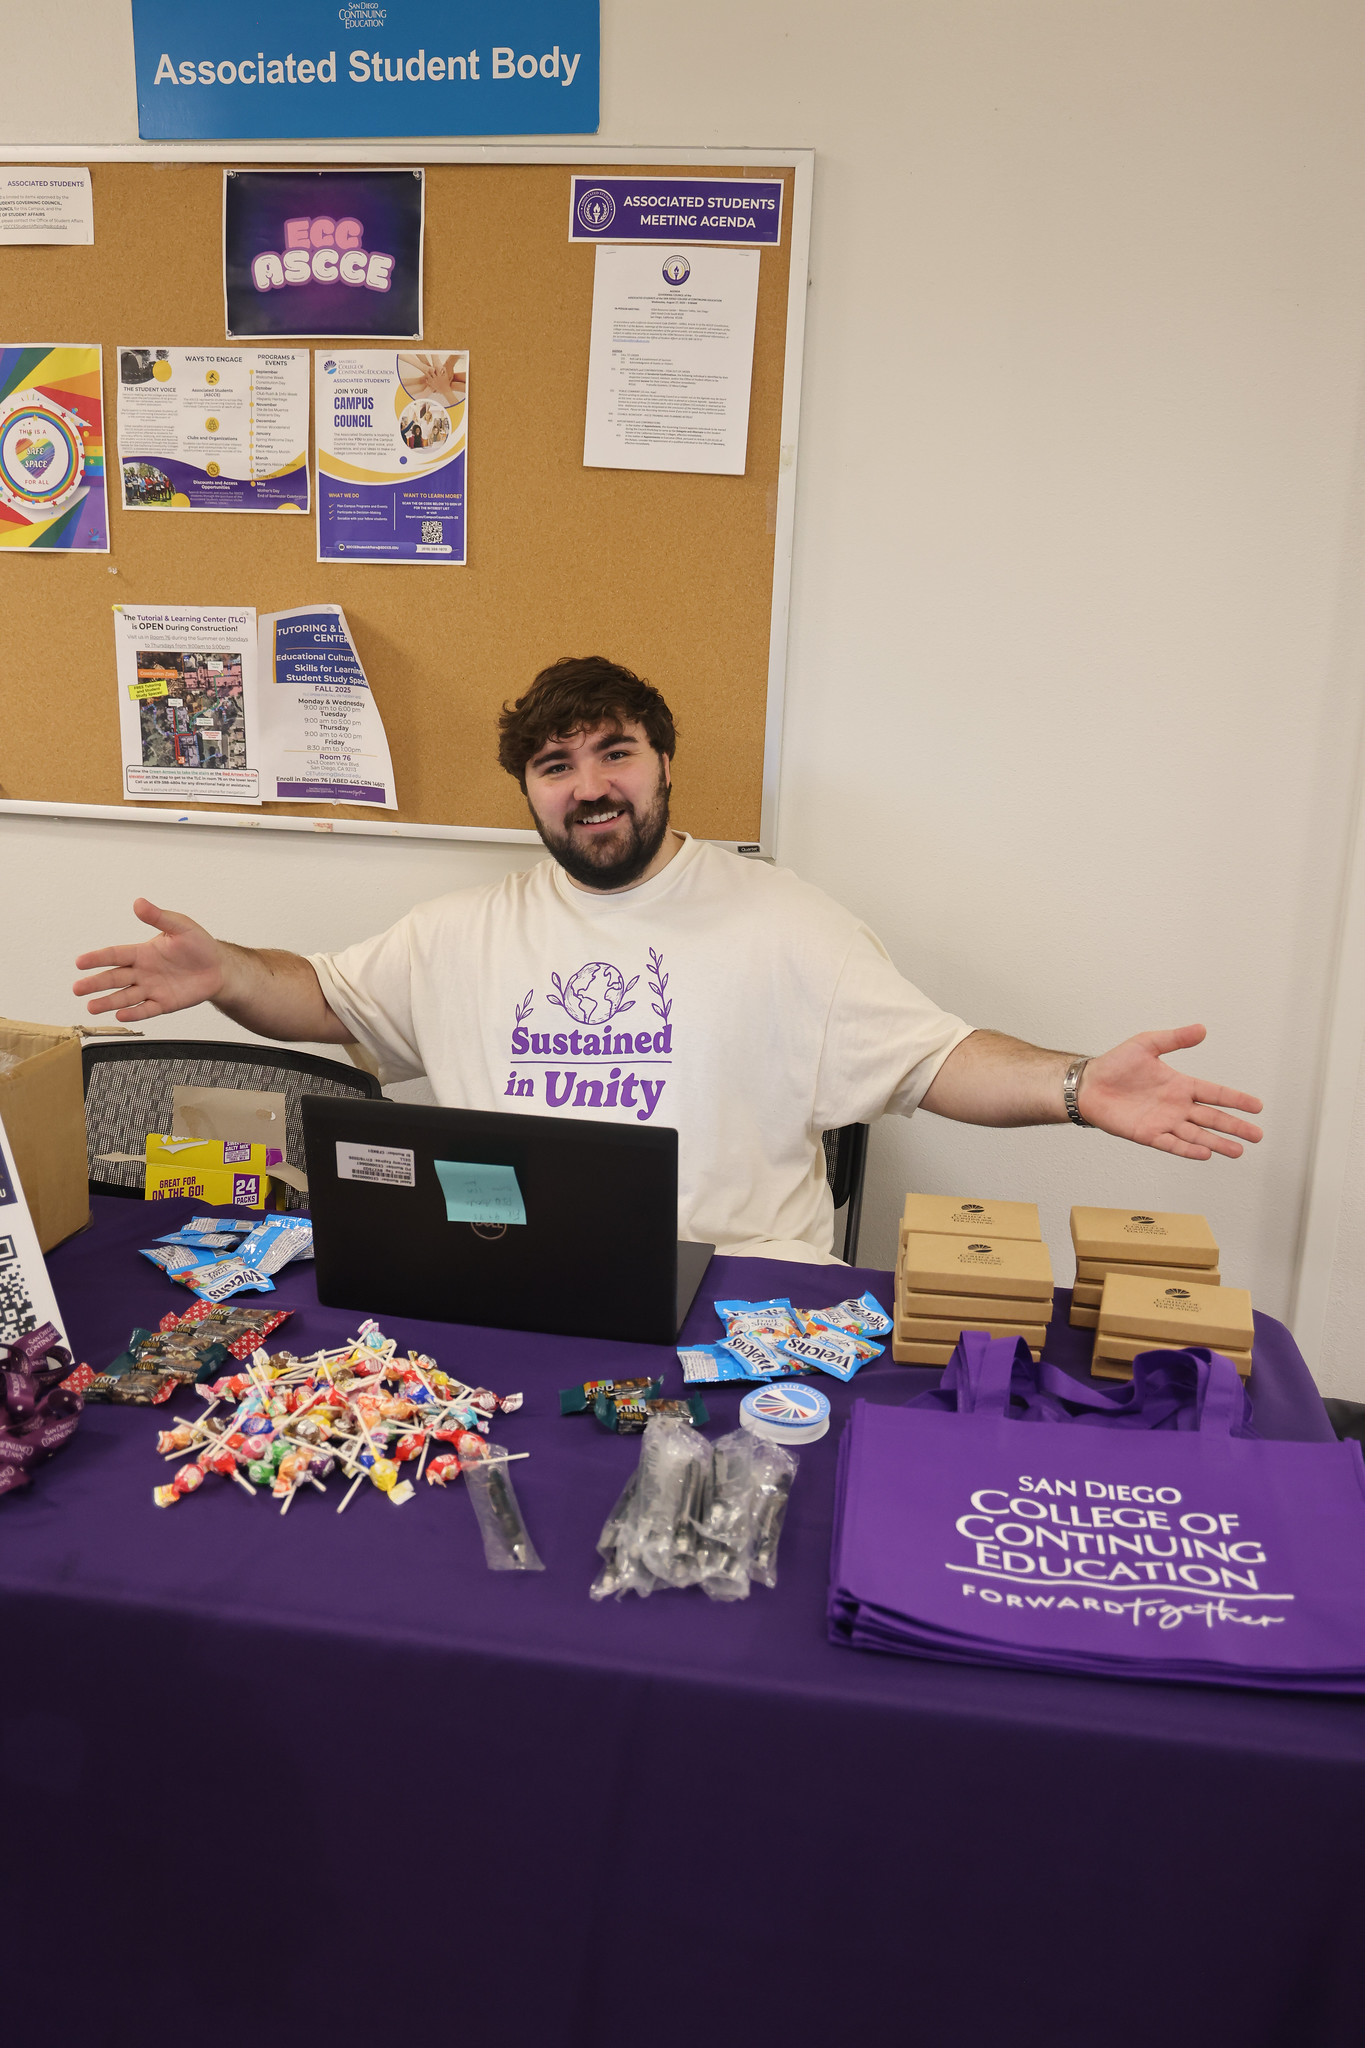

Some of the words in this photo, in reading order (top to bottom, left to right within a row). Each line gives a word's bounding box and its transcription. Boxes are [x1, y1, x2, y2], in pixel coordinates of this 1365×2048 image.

[339, 9, 387, 20] CONTINUING
[346, 19, 383, 29] EDUCATION
[154, 52, 336, 85] Associated
[349, 49, 480, 81] Student
[492, 46, 581, 87] Body
[624, 196, 703, 208] ASSOCIATED
[708, 198, 775, 210] STUDENTS
[640, 215, 697, 226] MEETING
[700, 216, 756, 228] AGENDA
[286, 219, 361, 250] ECC
[254, 248, 393, 290] ASCCE
[334, 397, 374, 409] CAMPUS
[334, 415, 373, 427] COUNCIL
[277, 624, 327, 635] TUTORING
[277, 653, 326, 661] Educational
[328, 654, 355, 662] Cultural
[334, 665, 362, 676] Learning
[323, 675, 348, 684] Study
[332, 700, 365, 708] Wednesday
[512, 1024, 672, 1056] Sustained
[504, 1071, 534, 1097] in
[545, 1068, 666, 1121] Unity
[160, 1177, 181, 1188] GREAT
[183, 1176, 196, 1186] FOR
[236, 1178, 256, 1195] 24
[152, 1189, 164, 1200] ON
[168, 1188, 185, 1198] THE
[188, 1185, 204, 1197] GO!
[237, 1195, 255, 1205] PACKS
[585, 1384, 614, 1397] KIND
[1018, 1475, 1077, 1497] SAN
[1085, 1480, 1182, 1505] DIEGO
[970, 1489, 1171, 1530] COLLEGE
[1179, 1512, 1240, 1535] OF
[955, 1514, 1267, 1563] CONTINUING
[976, 1542, 1259, 1590] EDUCATION
